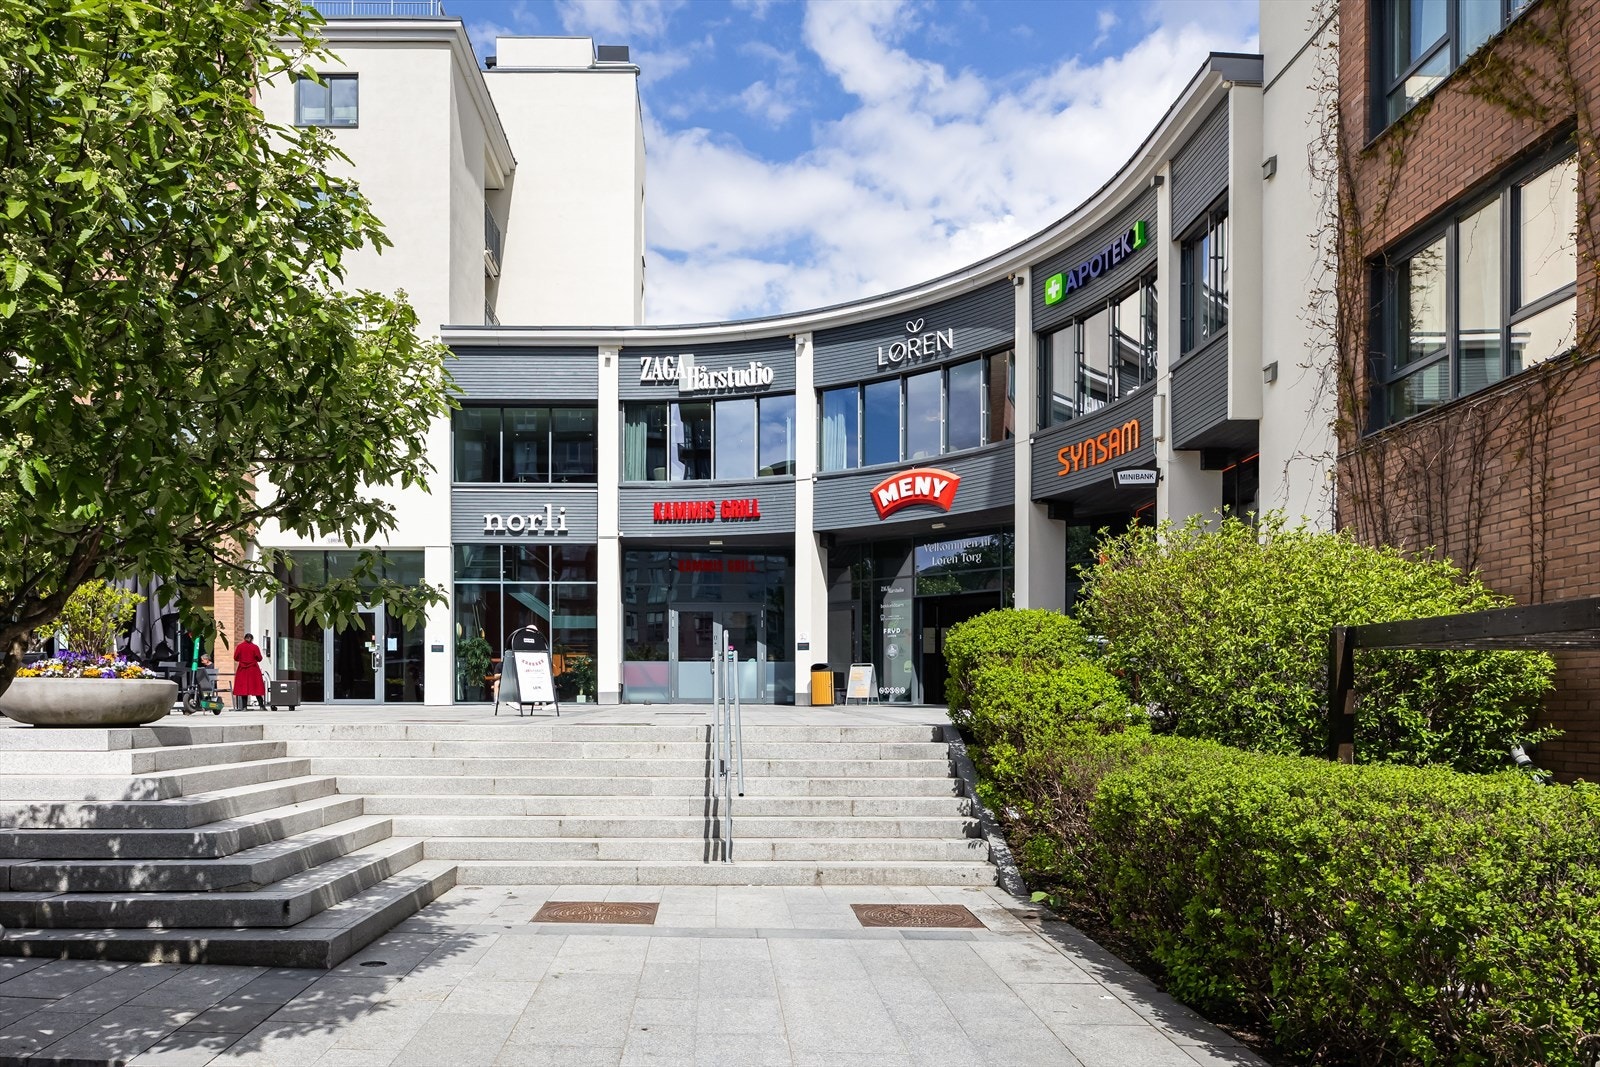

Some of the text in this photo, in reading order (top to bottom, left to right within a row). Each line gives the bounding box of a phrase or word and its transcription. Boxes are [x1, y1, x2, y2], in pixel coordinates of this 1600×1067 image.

[877, 327, 953, 366] LØREN
[640, 356, 774, 391] ZAGA Hårstudio
[1057, 418, 1140, 477] SYNSAM
[877, 476, 949, 507] MENY
[1120, 473, 1155, 481] MINIBANK
[483, 503, 569, 532] norli
[653, 498, 761, 520] KAMMIS GRILL
[923, 540, 978, 553] Velkommen
[960, 552, 982, 564] Torg
